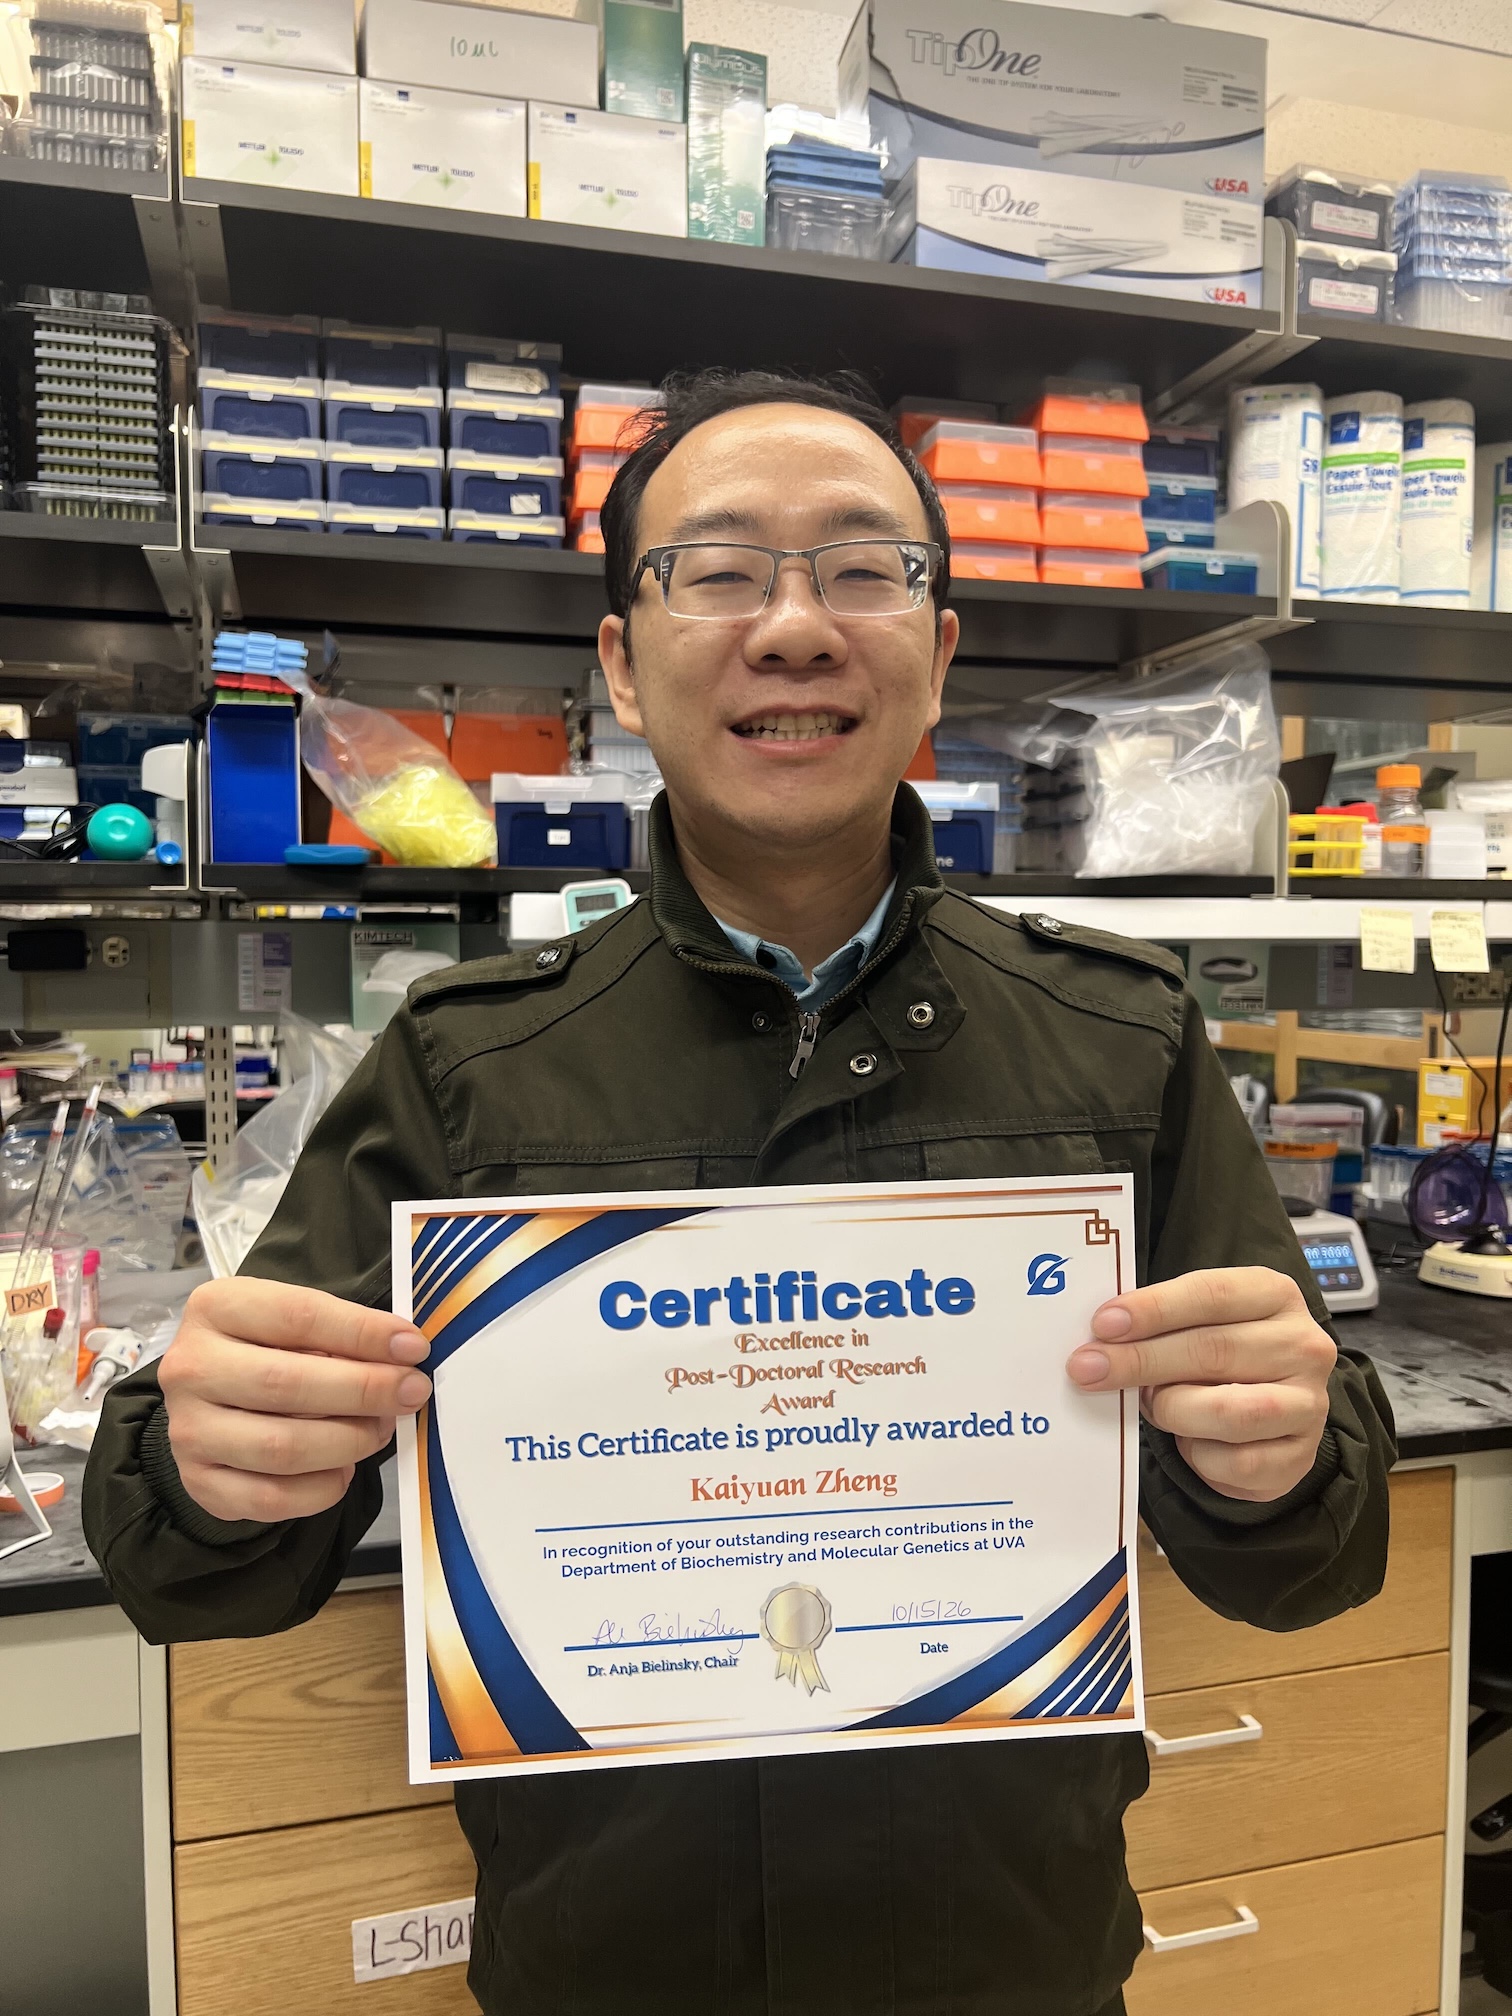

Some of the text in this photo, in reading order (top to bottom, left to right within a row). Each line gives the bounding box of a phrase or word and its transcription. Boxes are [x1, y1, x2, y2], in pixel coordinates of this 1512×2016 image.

[449, 36, 468, 58] 10
[906, 28, 1042, 76] TipOne
[1215, 178, 1249, 193] USA
[946, 184, 1040, 217] TipOne
[1214, 288, 1247, 304] USA
[1325, 468, 1363, 482] Paper
[1429, 472, 1466, 485] Towels
[354, 931, 414, 942] KIMTECH
[11, 1286, 50, 1313] DRY
[599, 1268, 976, 1331] Certificate
[734, 1328, 870, 1354] Excellence in
[665, 1355, 927, 1394] Post-Doctoral Research
[760, 1389, 836, 1416] Award
[505, 1410, 1050, 1462] This Certificate is proudly awarded to
[689, 1467, 898, 1505] Kaiyuan Zheng
[543, 1517, 1034, 1559] In recognition of your outstanding research contributions in the
[561, 1536, 1025, 1579] Department of Biochemistry and Molecular Genetics at UVA
[892, 1599, 972, 1623] 10/15/26
[920, 1642, 949, 1655] Date
[587, 1656, 739, 1677] Dr. Anja Bielinsky, Chair
